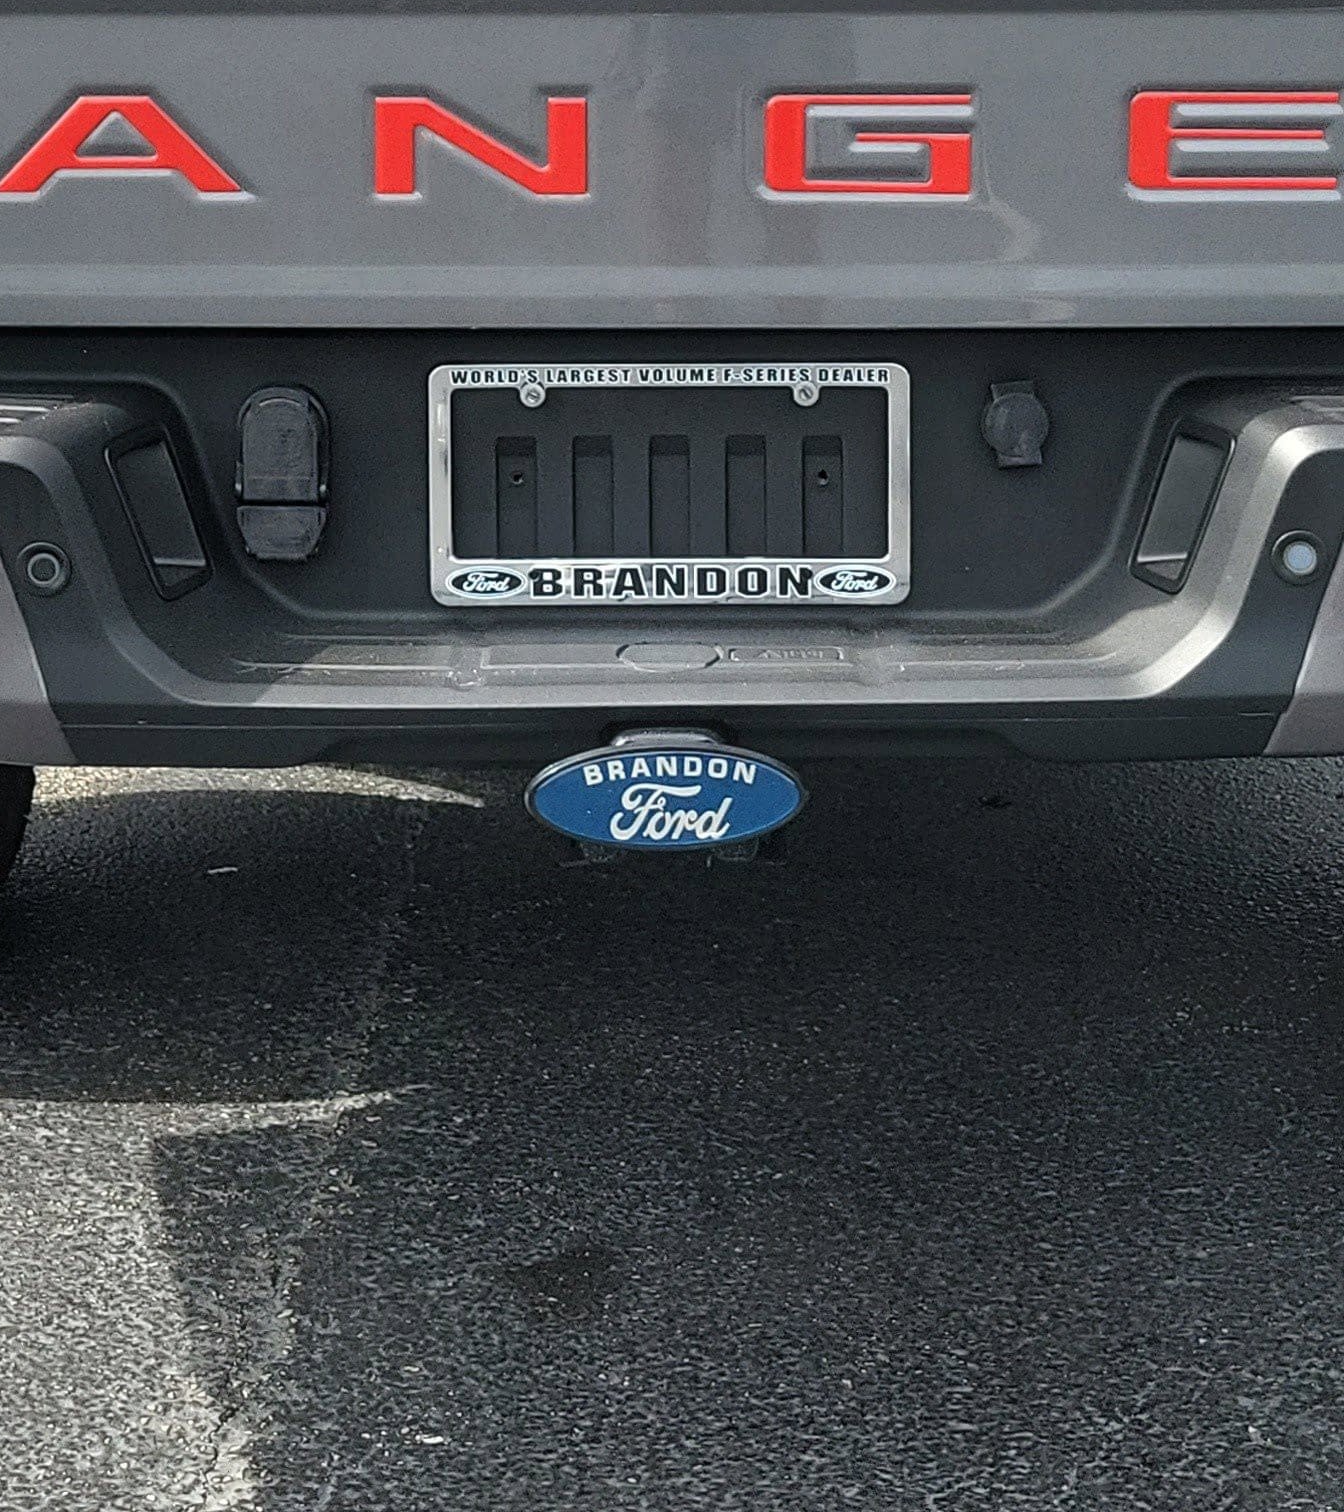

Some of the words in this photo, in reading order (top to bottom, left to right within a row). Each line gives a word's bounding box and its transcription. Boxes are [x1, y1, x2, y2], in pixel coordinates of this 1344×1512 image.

[451, 369, 539, 385] WORLD'S
[545, 369, 632, 384] LARGEST
[639, 369, 716, 383] VOLUME
[723, 368, 811, 383] F-SERIES
[817, 368, 890, 383] DEALER
[462, 572, 510, 593] Ford
[529, 567, 813, 597] BRANDON
[830, 570, 878, 591] Ford
[583, 756, 757, 786] BRANDON
[610, 783, 733, 840] Ford
